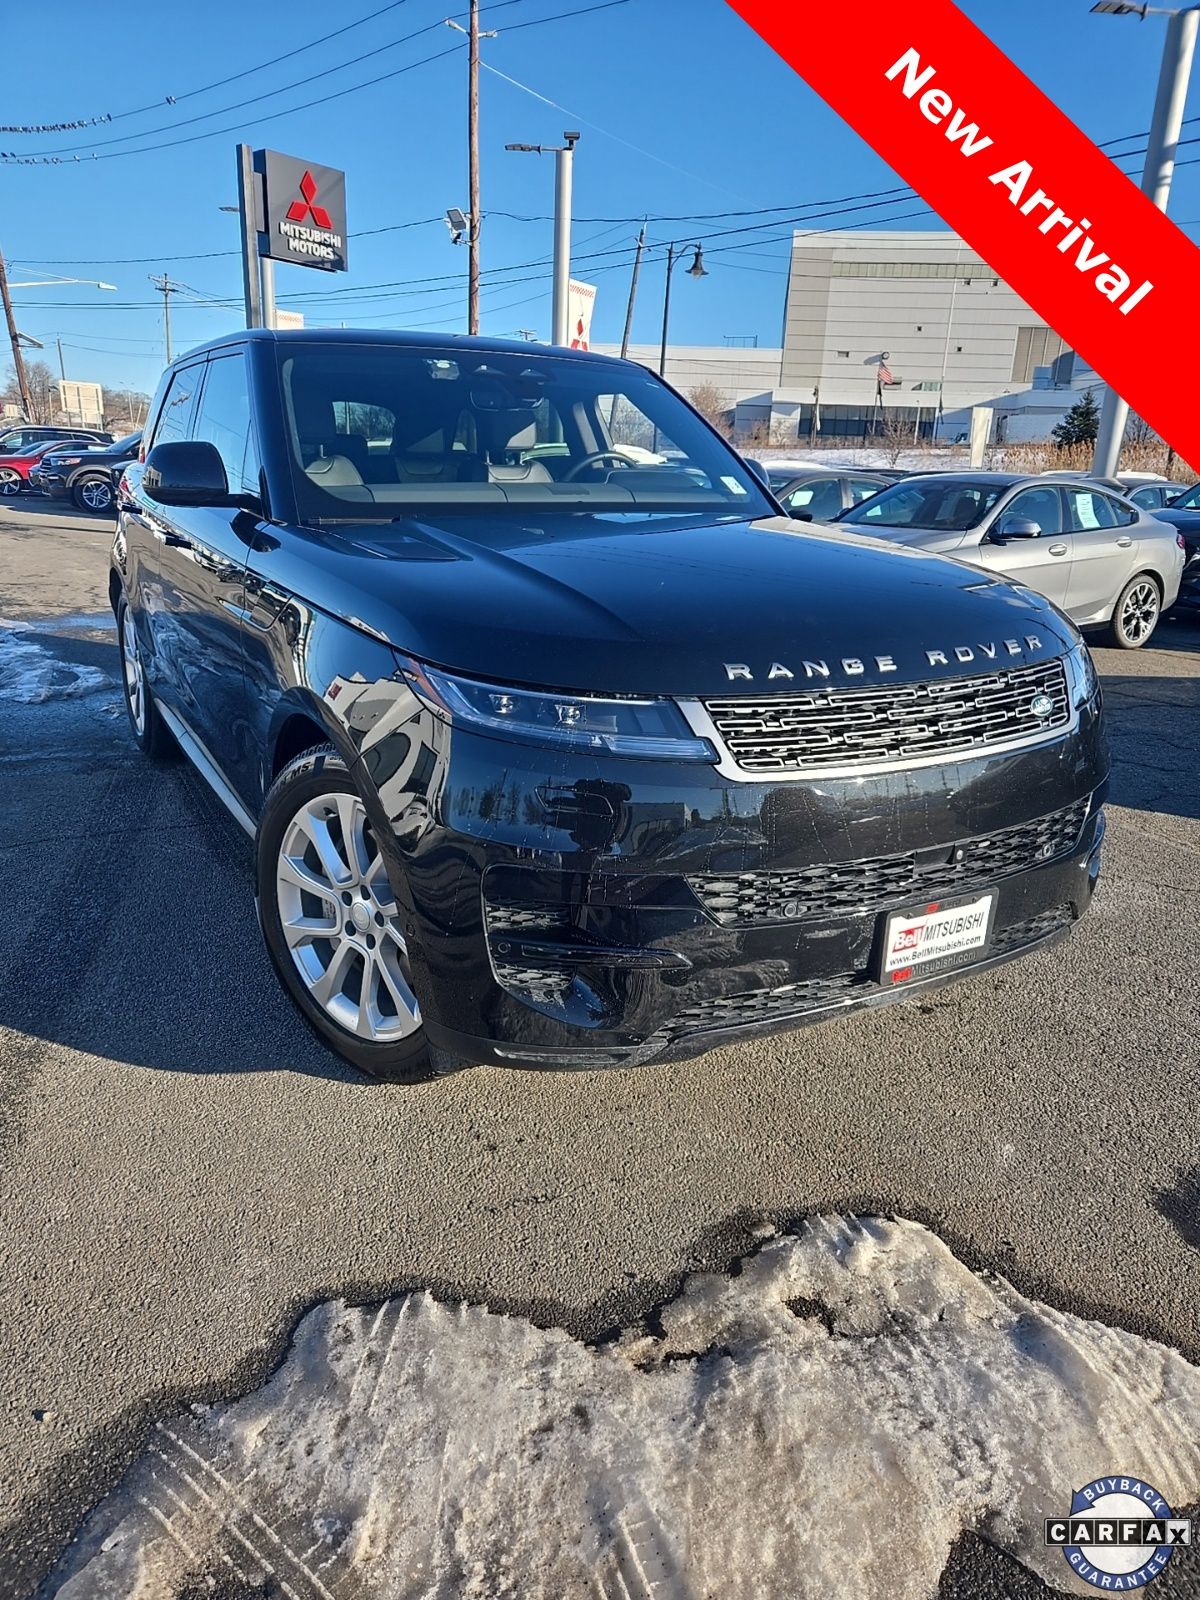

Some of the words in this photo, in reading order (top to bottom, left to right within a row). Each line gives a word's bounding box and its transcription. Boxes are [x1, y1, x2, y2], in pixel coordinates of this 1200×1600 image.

[279, 221, 342, 248] MITSUBISHI
[288, 237, 335, 259] MOTORS
[724, 655, 899, 680] RANGE
[925, 635, 1043, 666] ROVER
[892, 923, 926, 953] Bell
[922, 912, 985, 942] MITSUBISHI
[889, 935, 982, 966] www.BellMitsubishi.com
